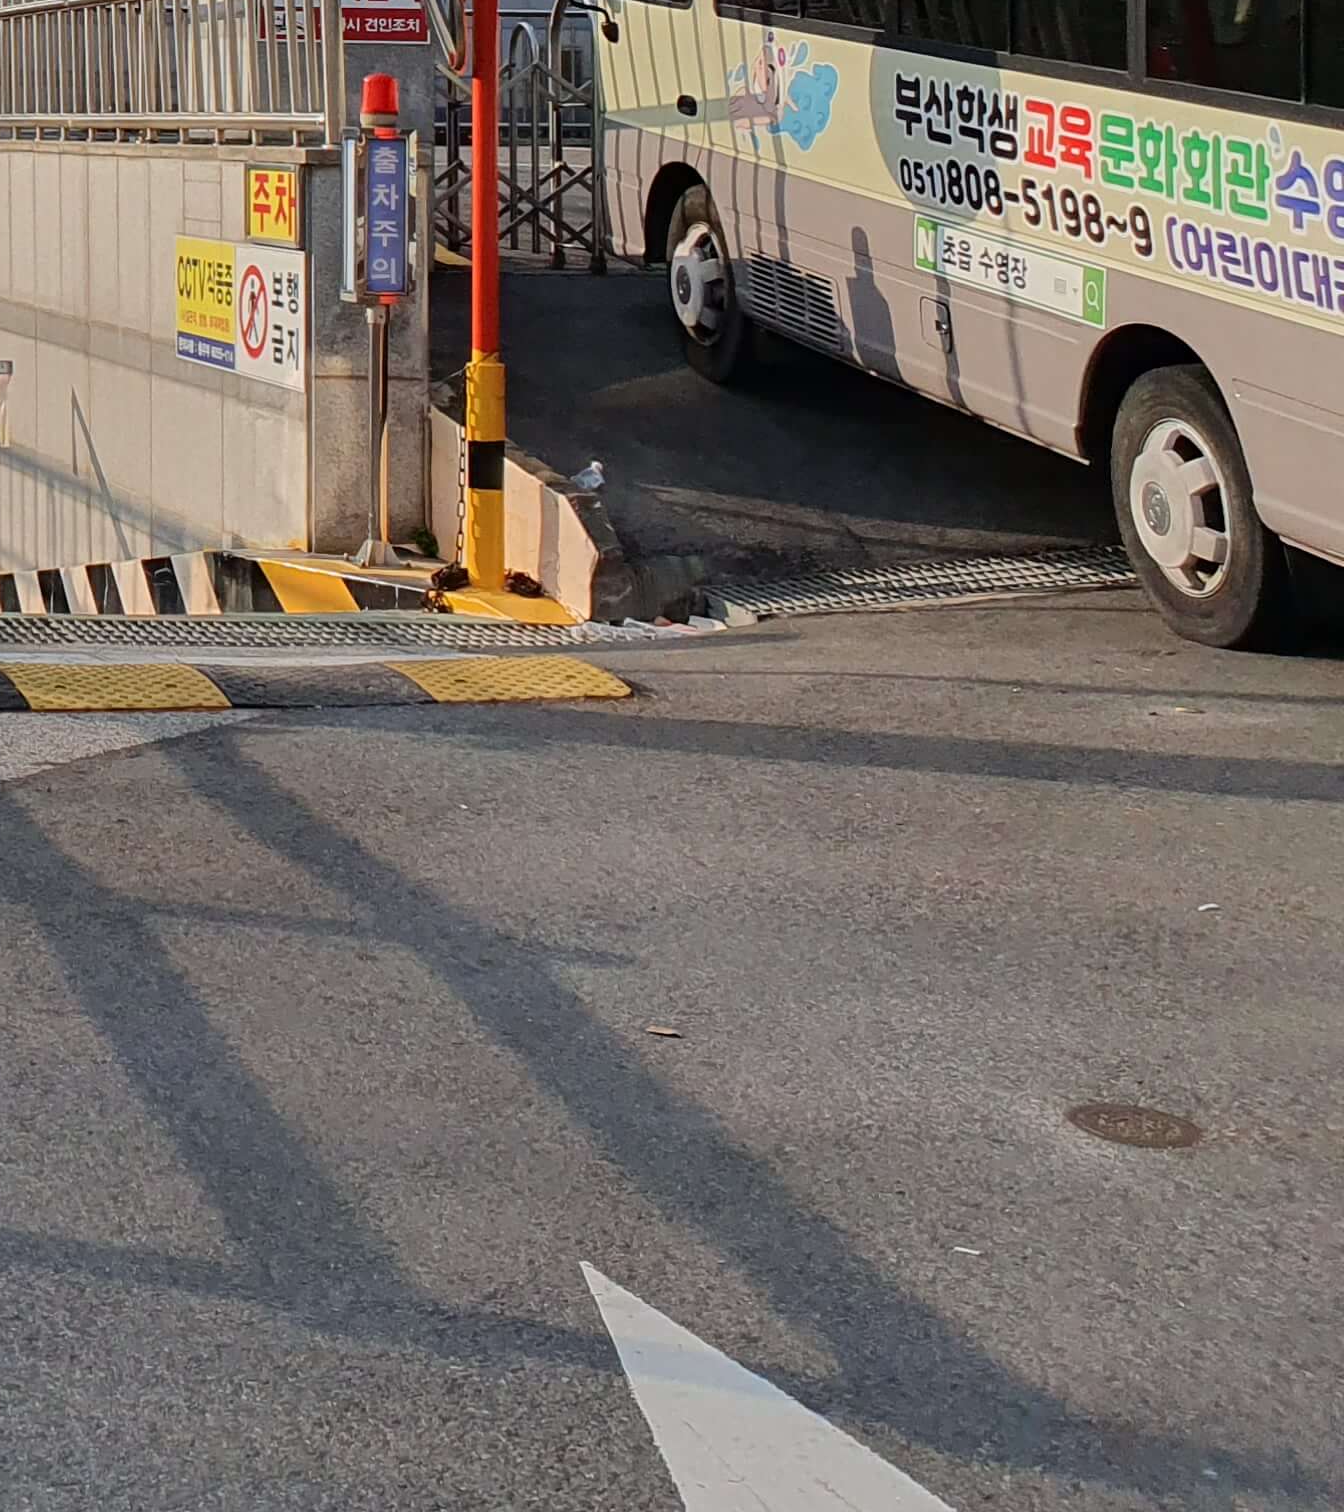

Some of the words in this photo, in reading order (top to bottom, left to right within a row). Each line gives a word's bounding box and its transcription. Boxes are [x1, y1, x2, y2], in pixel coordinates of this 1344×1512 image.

[364, 18, 420, 33] 견인조치
[253, 173, 297, 236] 주차
[371, 146, 400, 285] 출차주의
[900, 158, 1153, 257] 051)808-5198~9
[942, 236, 973, 272] 초읍
[978, 247, 1028, 290] 수영장
[272, 271, 300, 315] 보행
[272, 324, 300, 371] 금지
